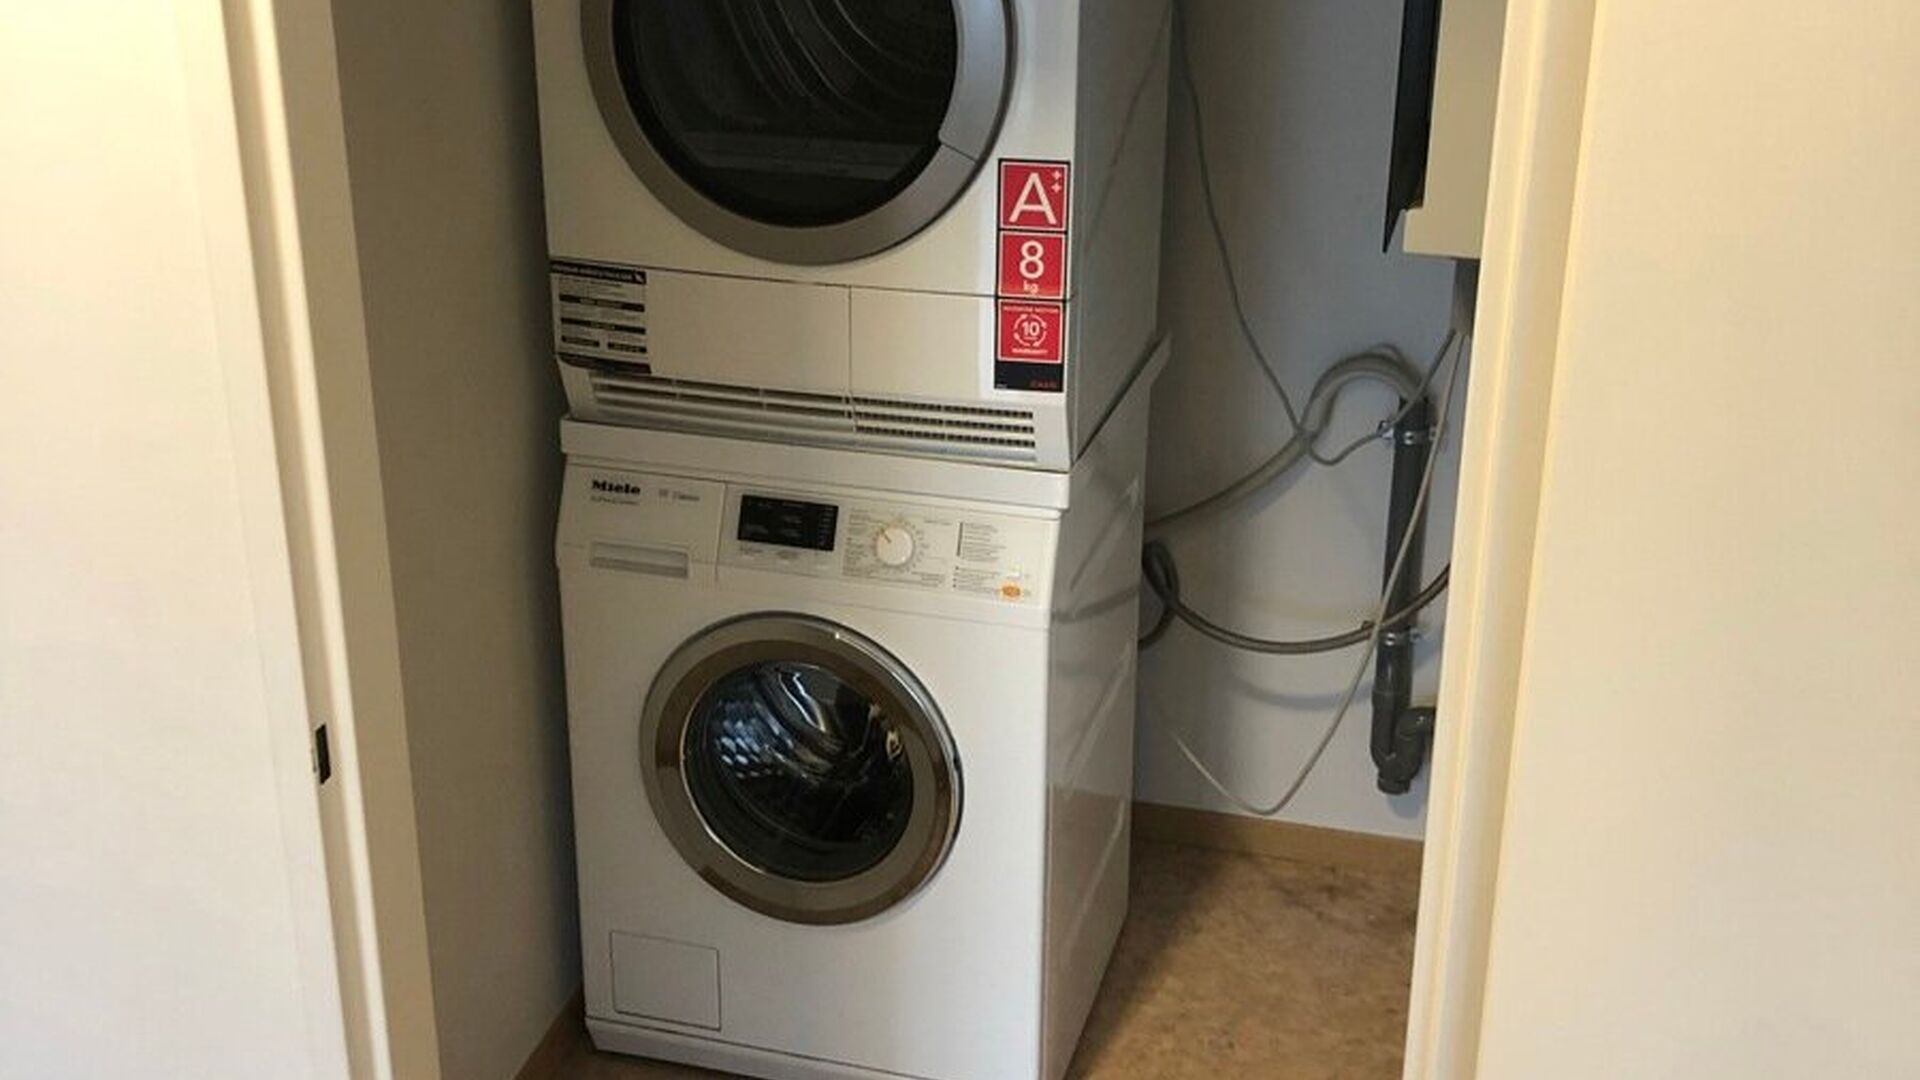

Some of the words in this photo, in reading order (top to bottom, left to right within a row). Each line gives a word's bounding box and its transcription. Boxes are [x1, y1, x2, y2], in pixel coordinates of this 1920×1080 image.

[1019, 240, 1044, 279] 8
[1023, 280, 1039, 294] kg
[1021, 321, 1040, 337] 10
[591, 480, 640, 494] Miele
